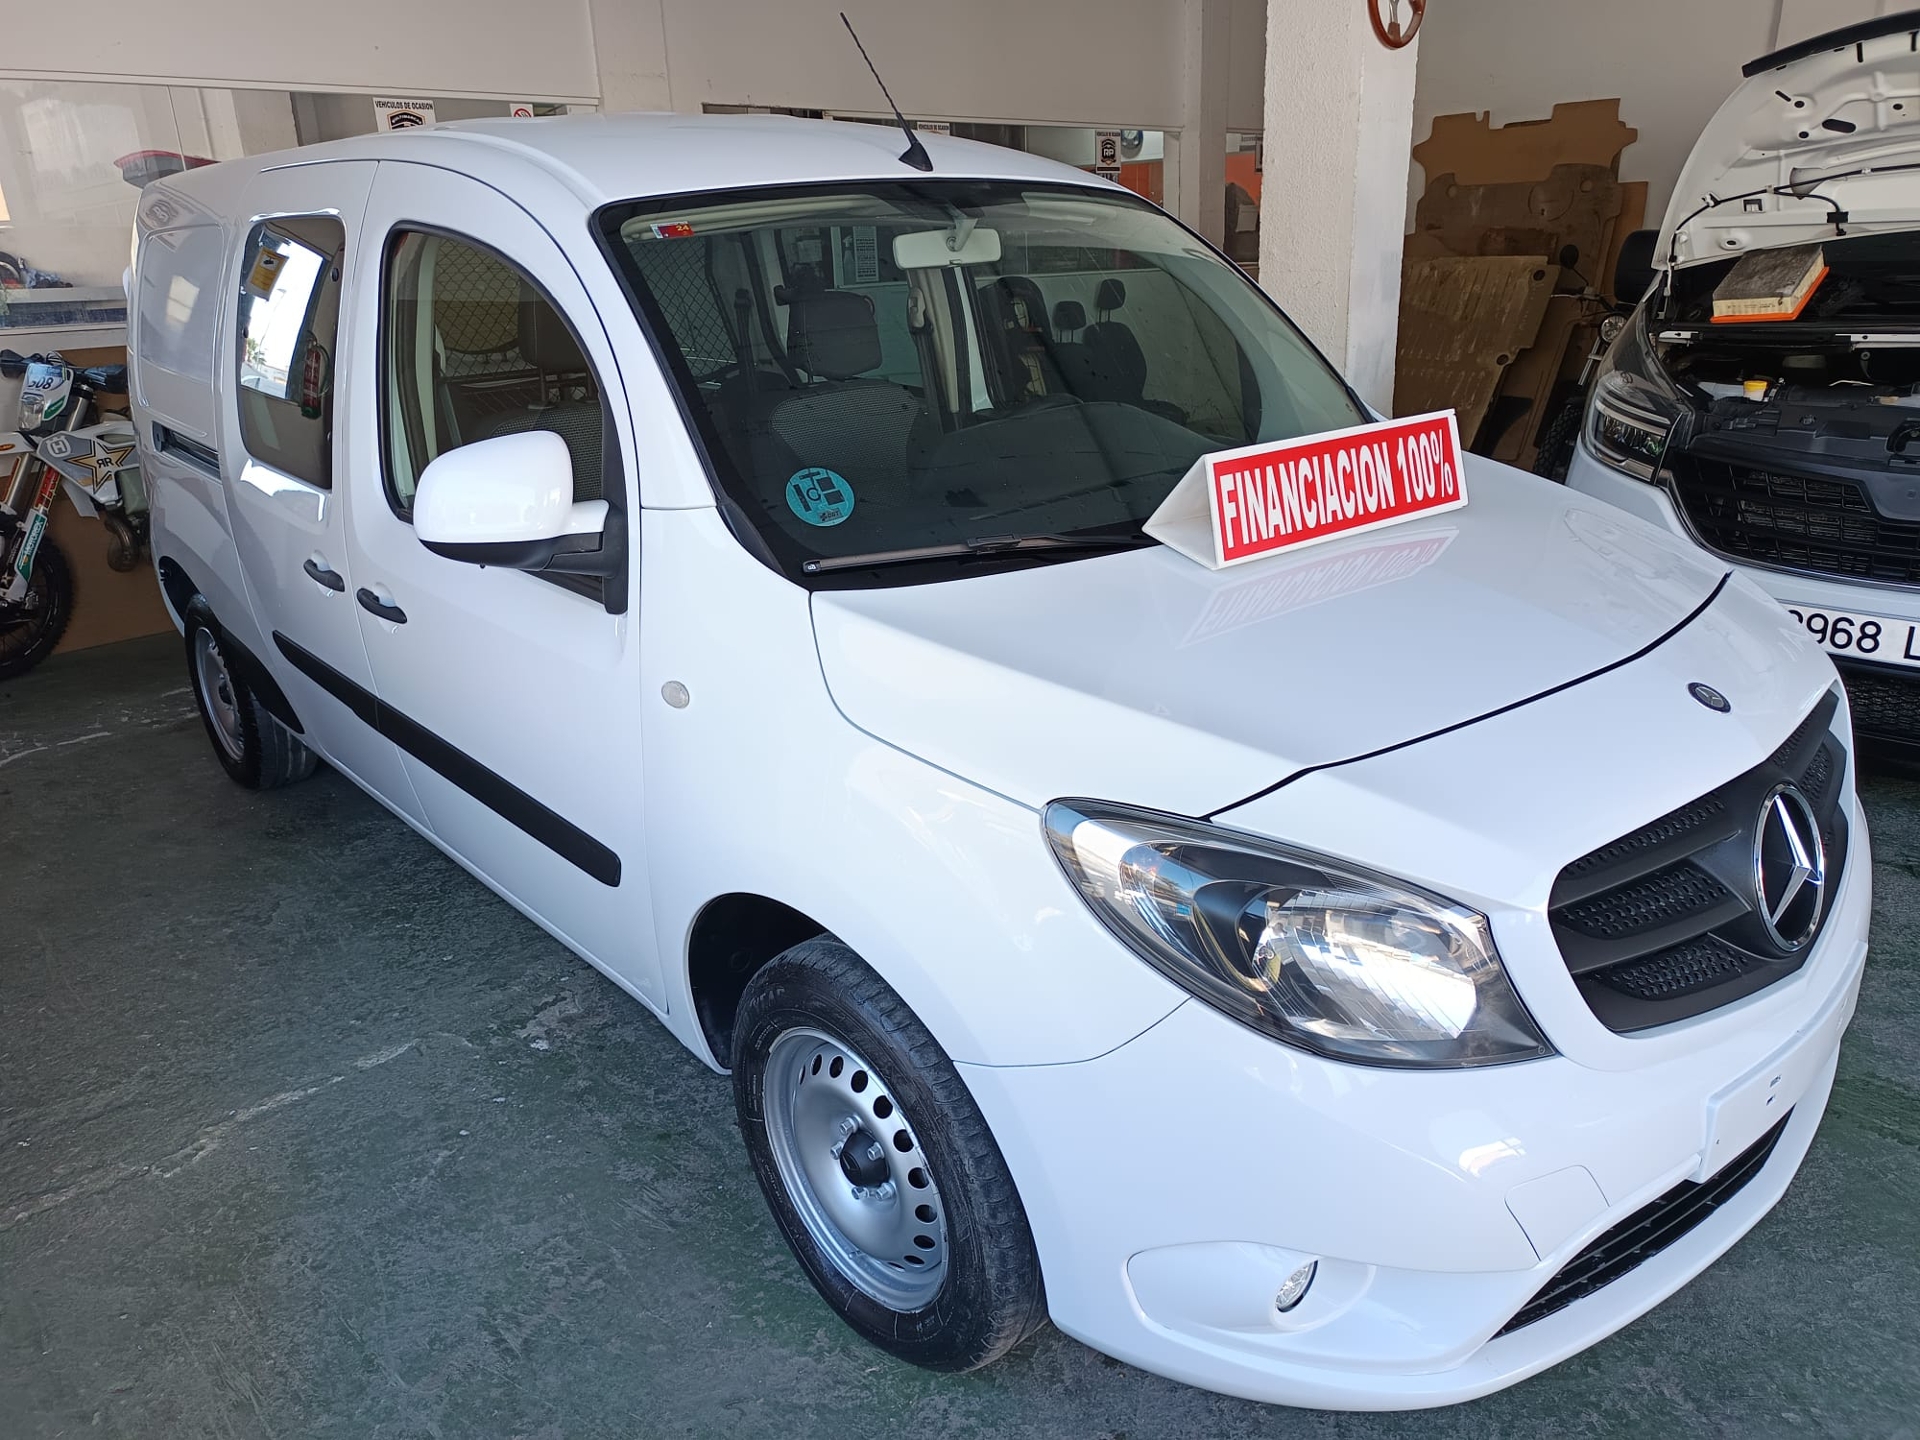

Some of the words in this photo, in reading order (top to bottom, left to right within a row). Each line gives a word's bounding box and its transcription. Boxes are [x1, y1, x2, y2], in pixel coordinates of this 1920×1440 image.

[375, 101, 403, 109] VEHICULOS
[412, 102, 434, 110] OCASION
[1220, 442, 1395, 548] FINANCIACION
[1397, 429, 1453, 503] 100%
[23, 520, 43, 555] MOTOREX
